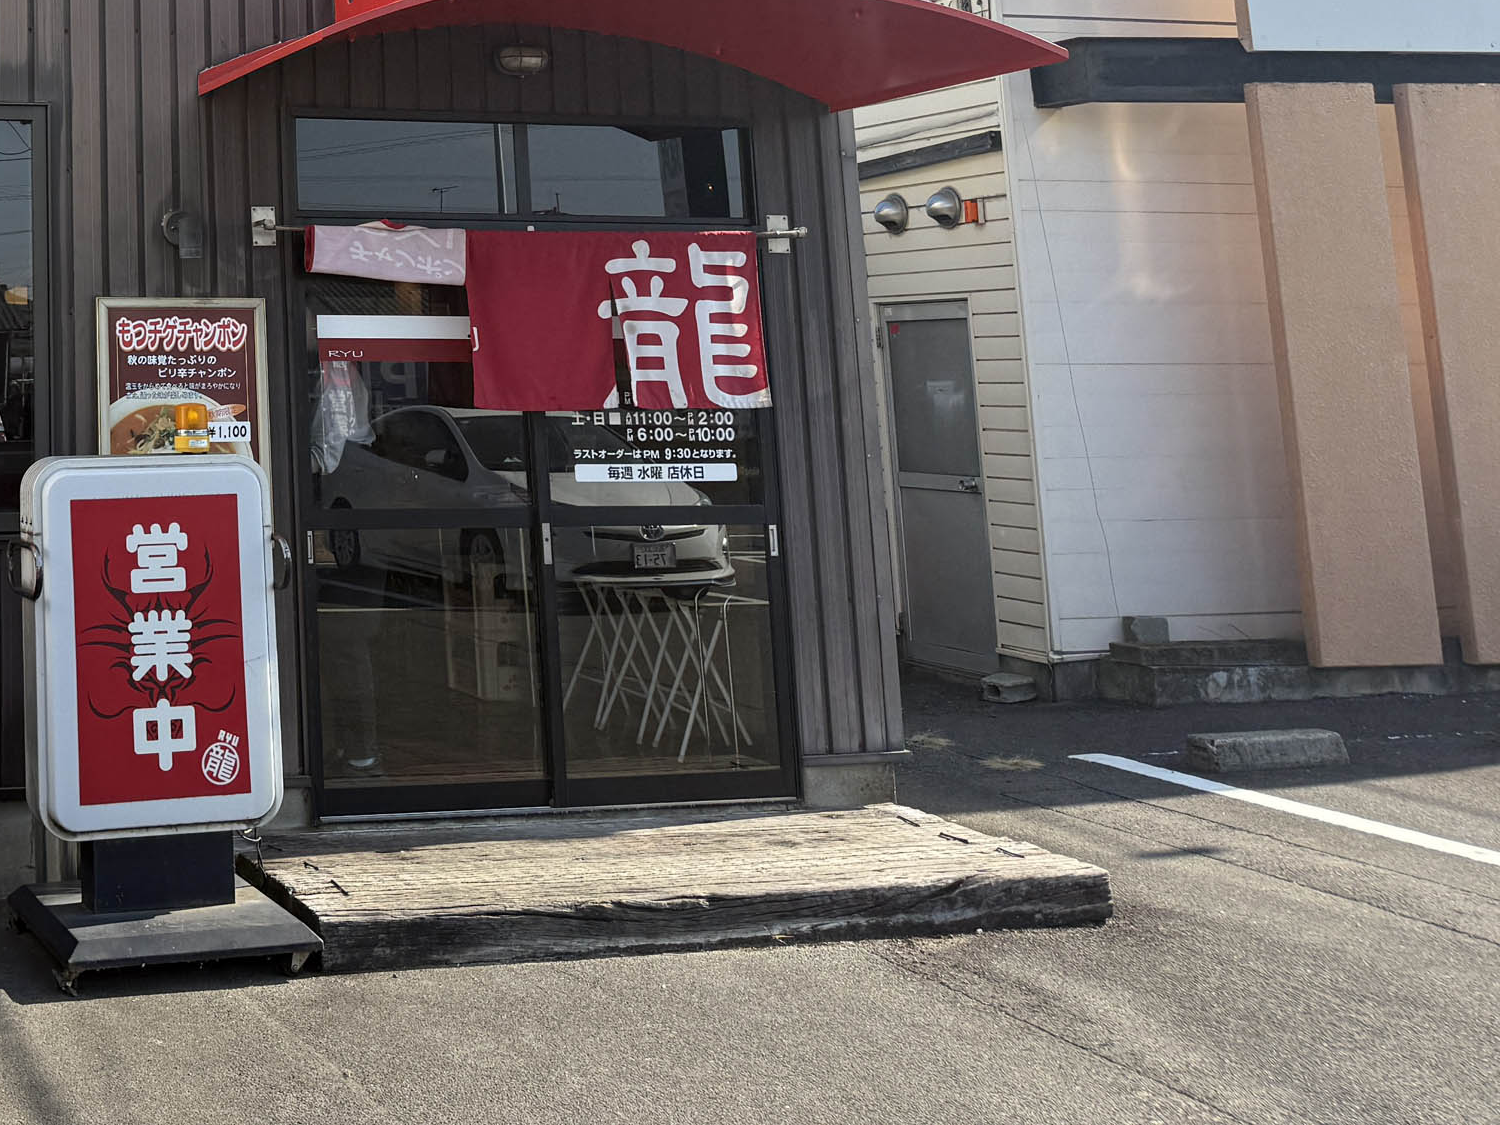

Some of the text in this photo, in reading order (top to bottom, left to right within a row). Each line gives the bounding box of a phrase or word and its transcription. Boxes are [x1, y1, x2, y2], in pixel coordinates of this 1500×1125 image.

[597, 239, 773, 409] 龍
[116, 316, 247, 352] もつチゲチャンポン
[127, 354, 217, 366] 秋の味覚たっぷりの
[328, 350, 364, 358] RYU
[158, 368, 237, 379] ピリ辛チャンポン
[698, 411, 734, 425] 2:00
[607, 466, 704, 479] 毎週 水曜 店休日
[125, 522, 197, 772] 営業中
[217, 729, 240, 748] RYU
[203, 743, 239, 783] 龍
